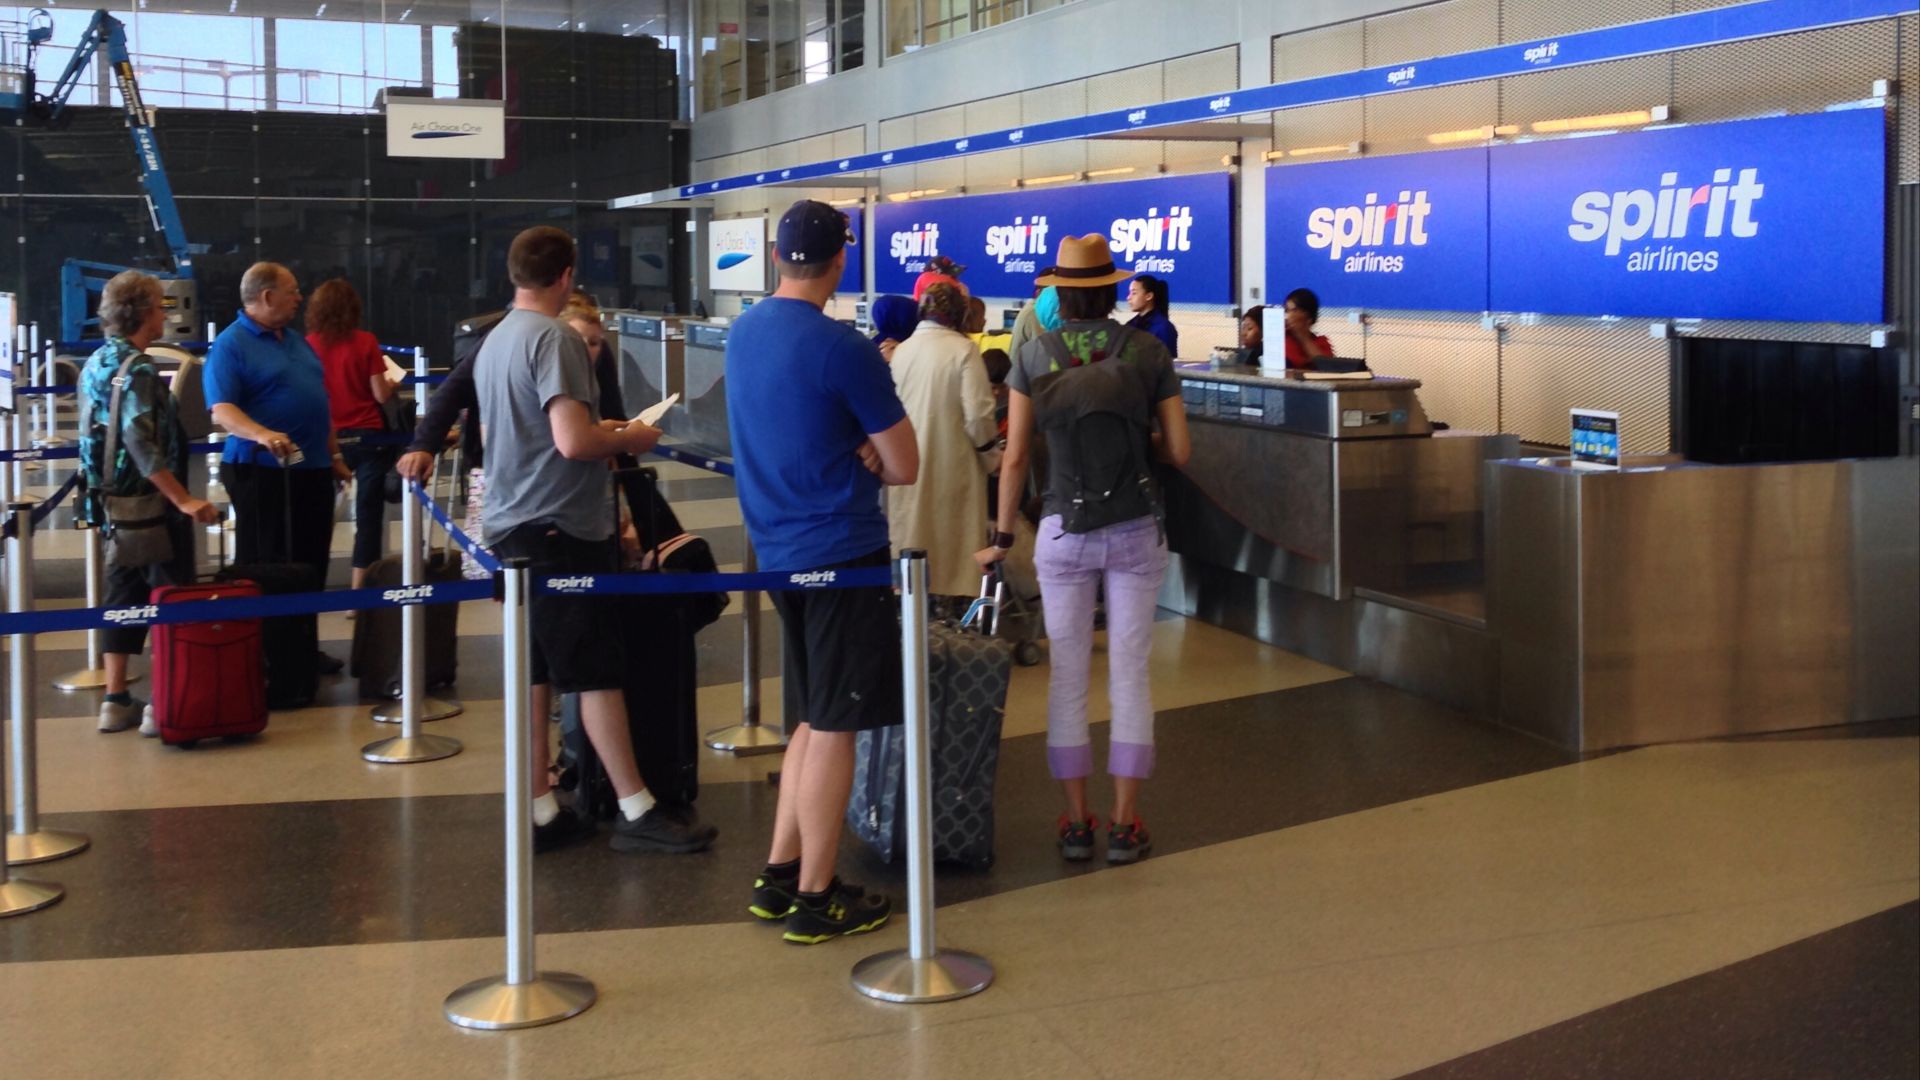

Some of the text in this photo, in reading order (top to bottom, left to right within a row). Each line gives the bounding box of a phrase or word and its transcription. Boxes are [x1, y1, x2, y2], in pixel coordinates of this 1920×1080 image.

[1523, 42, 1559, 62] spirit
[1387, 66, 1416, 84] spirit
[461, 123, 482, 132] One
[1568, 168, 1764, 256] spirit
[1109, 206, 1192, 262] spirit
[1306, 190, 1431, 260] spirit
[890, 223, 939, 265] spirit
[985, 216, 1049, 264] spirit
[1004, 258, 1036, 273] airlines
[1134, 256, 1175, 273] airlines
[1344, 251, 1404, 273] airlines
[1626, 246, 1719, 272] airlines
[547, 576, 594, 589] spirit
[789, 570, 836, 585] spirit
[383, 585, 433, 601] spirit
[103, 605, 159, 622] spirit
